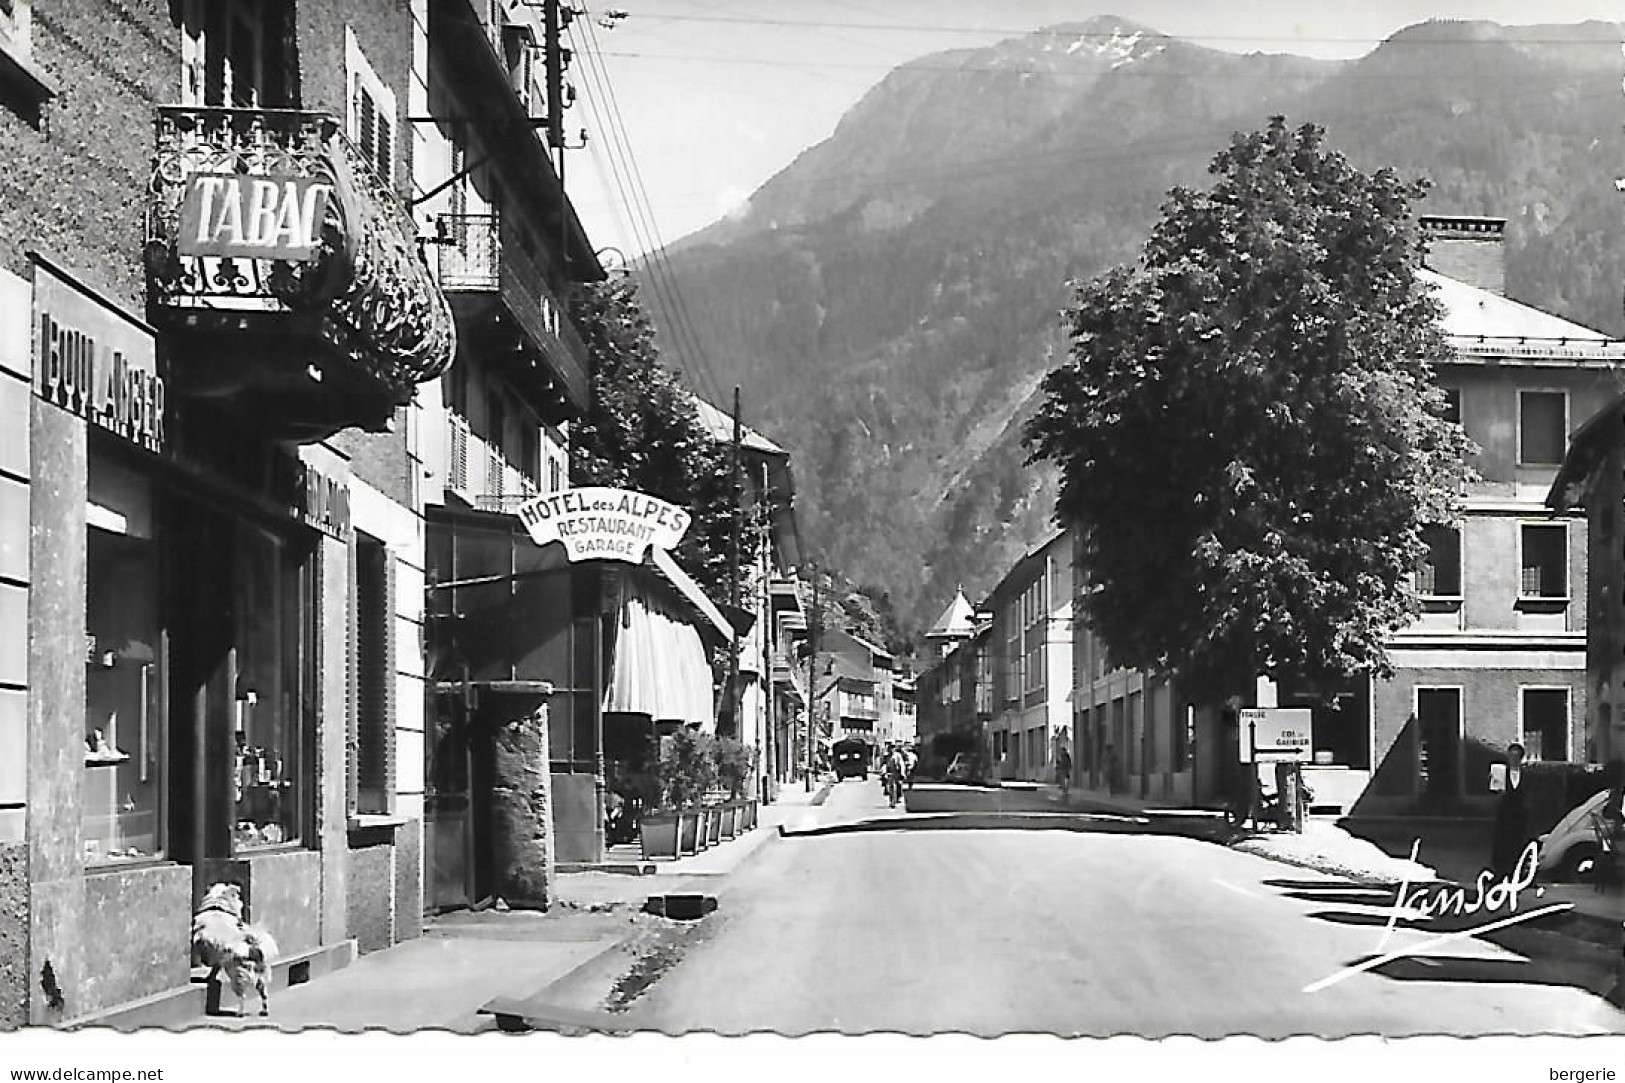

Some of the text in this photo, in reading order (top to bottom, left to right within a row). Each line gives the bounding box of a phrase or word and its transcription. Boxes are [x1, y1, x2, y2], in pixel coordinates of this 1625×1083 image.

[194, 176, 335, 249] TABAC
[520, 492, 684, 532] HOTEL des ALPES
[556, 516, 656, 542] RESTAURANT
[574, 538, 635, 556] GARAGE
[1281, 730, 1296, 738] COL
